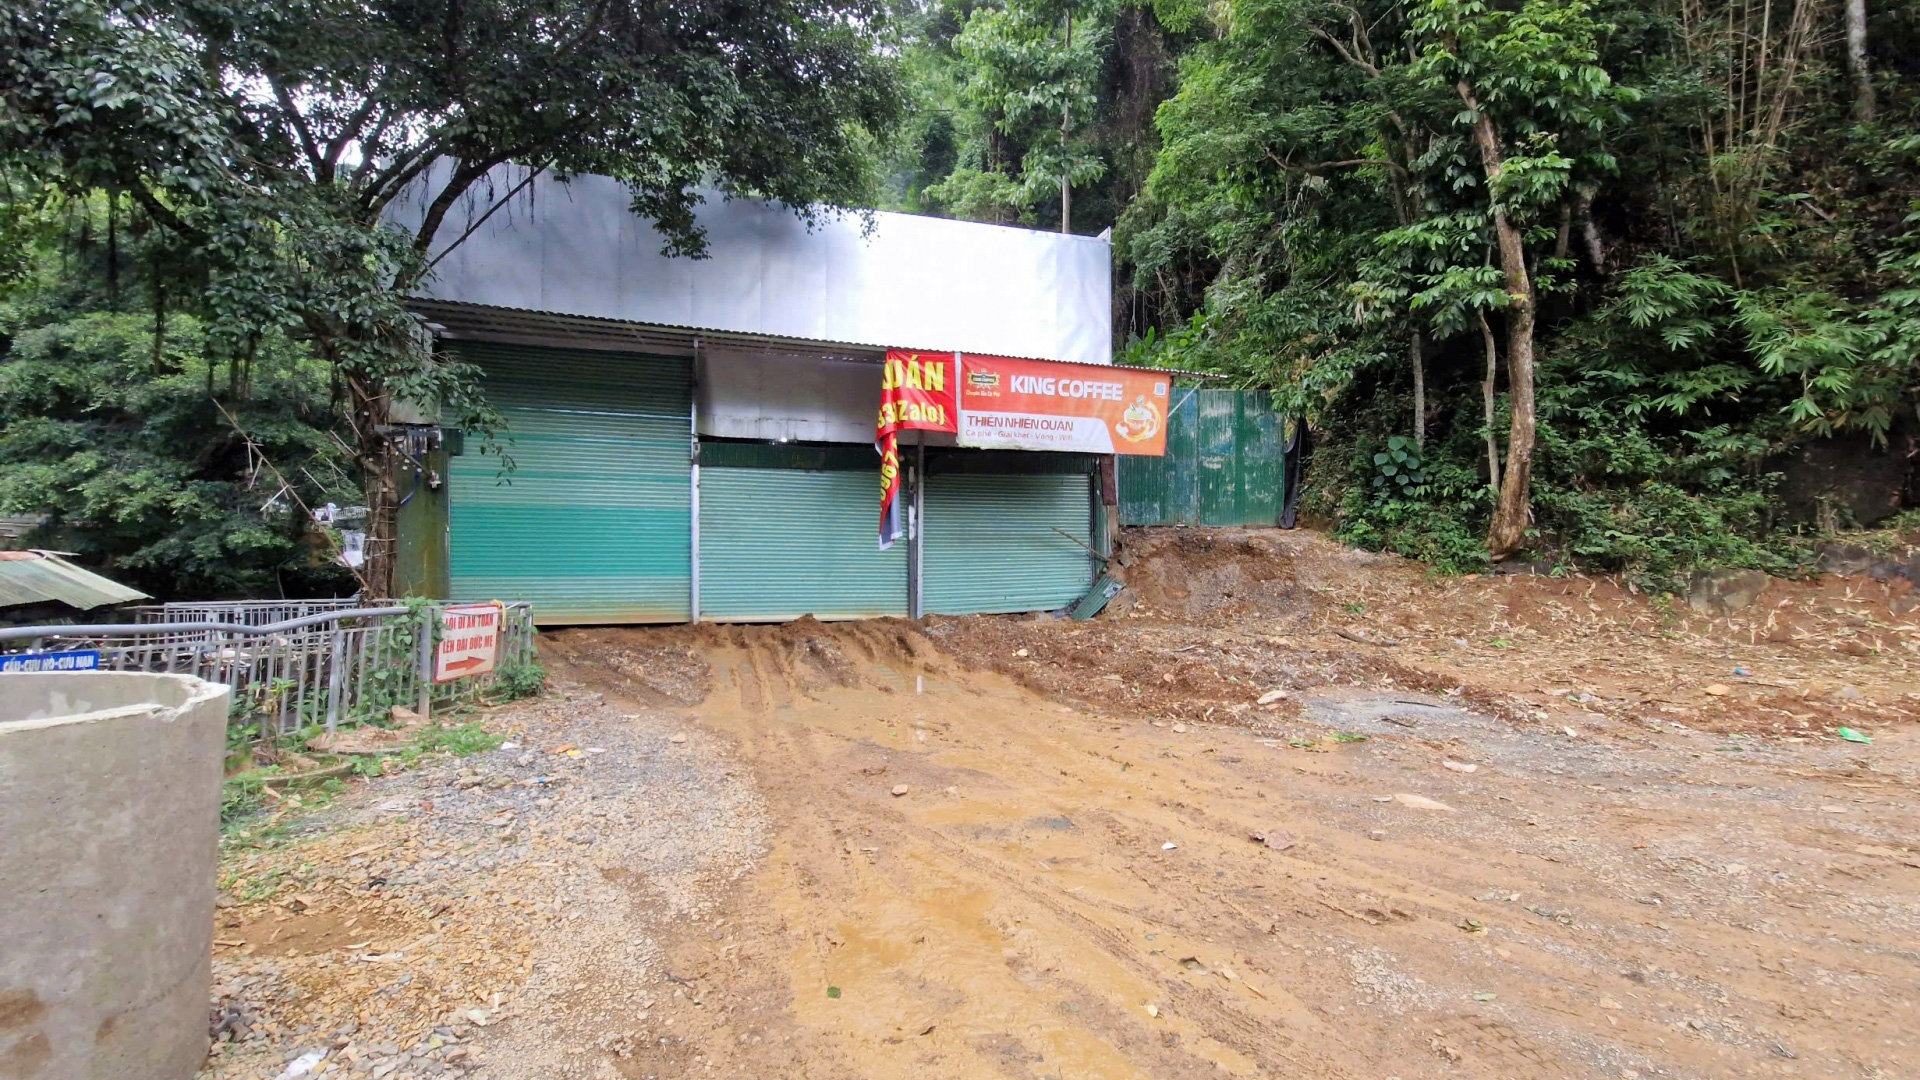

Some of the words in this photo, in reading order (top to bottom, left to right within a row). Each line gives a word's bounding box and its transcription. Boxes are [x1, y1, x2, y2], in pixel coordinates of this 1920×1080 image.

[1010, 374, 1055, 396] KING
[1058, 379, 1123, 401] COFFEE
[967, 414, 1003, 427] THIÊN
[1005, 415, 1039, 429] NHIÊN
